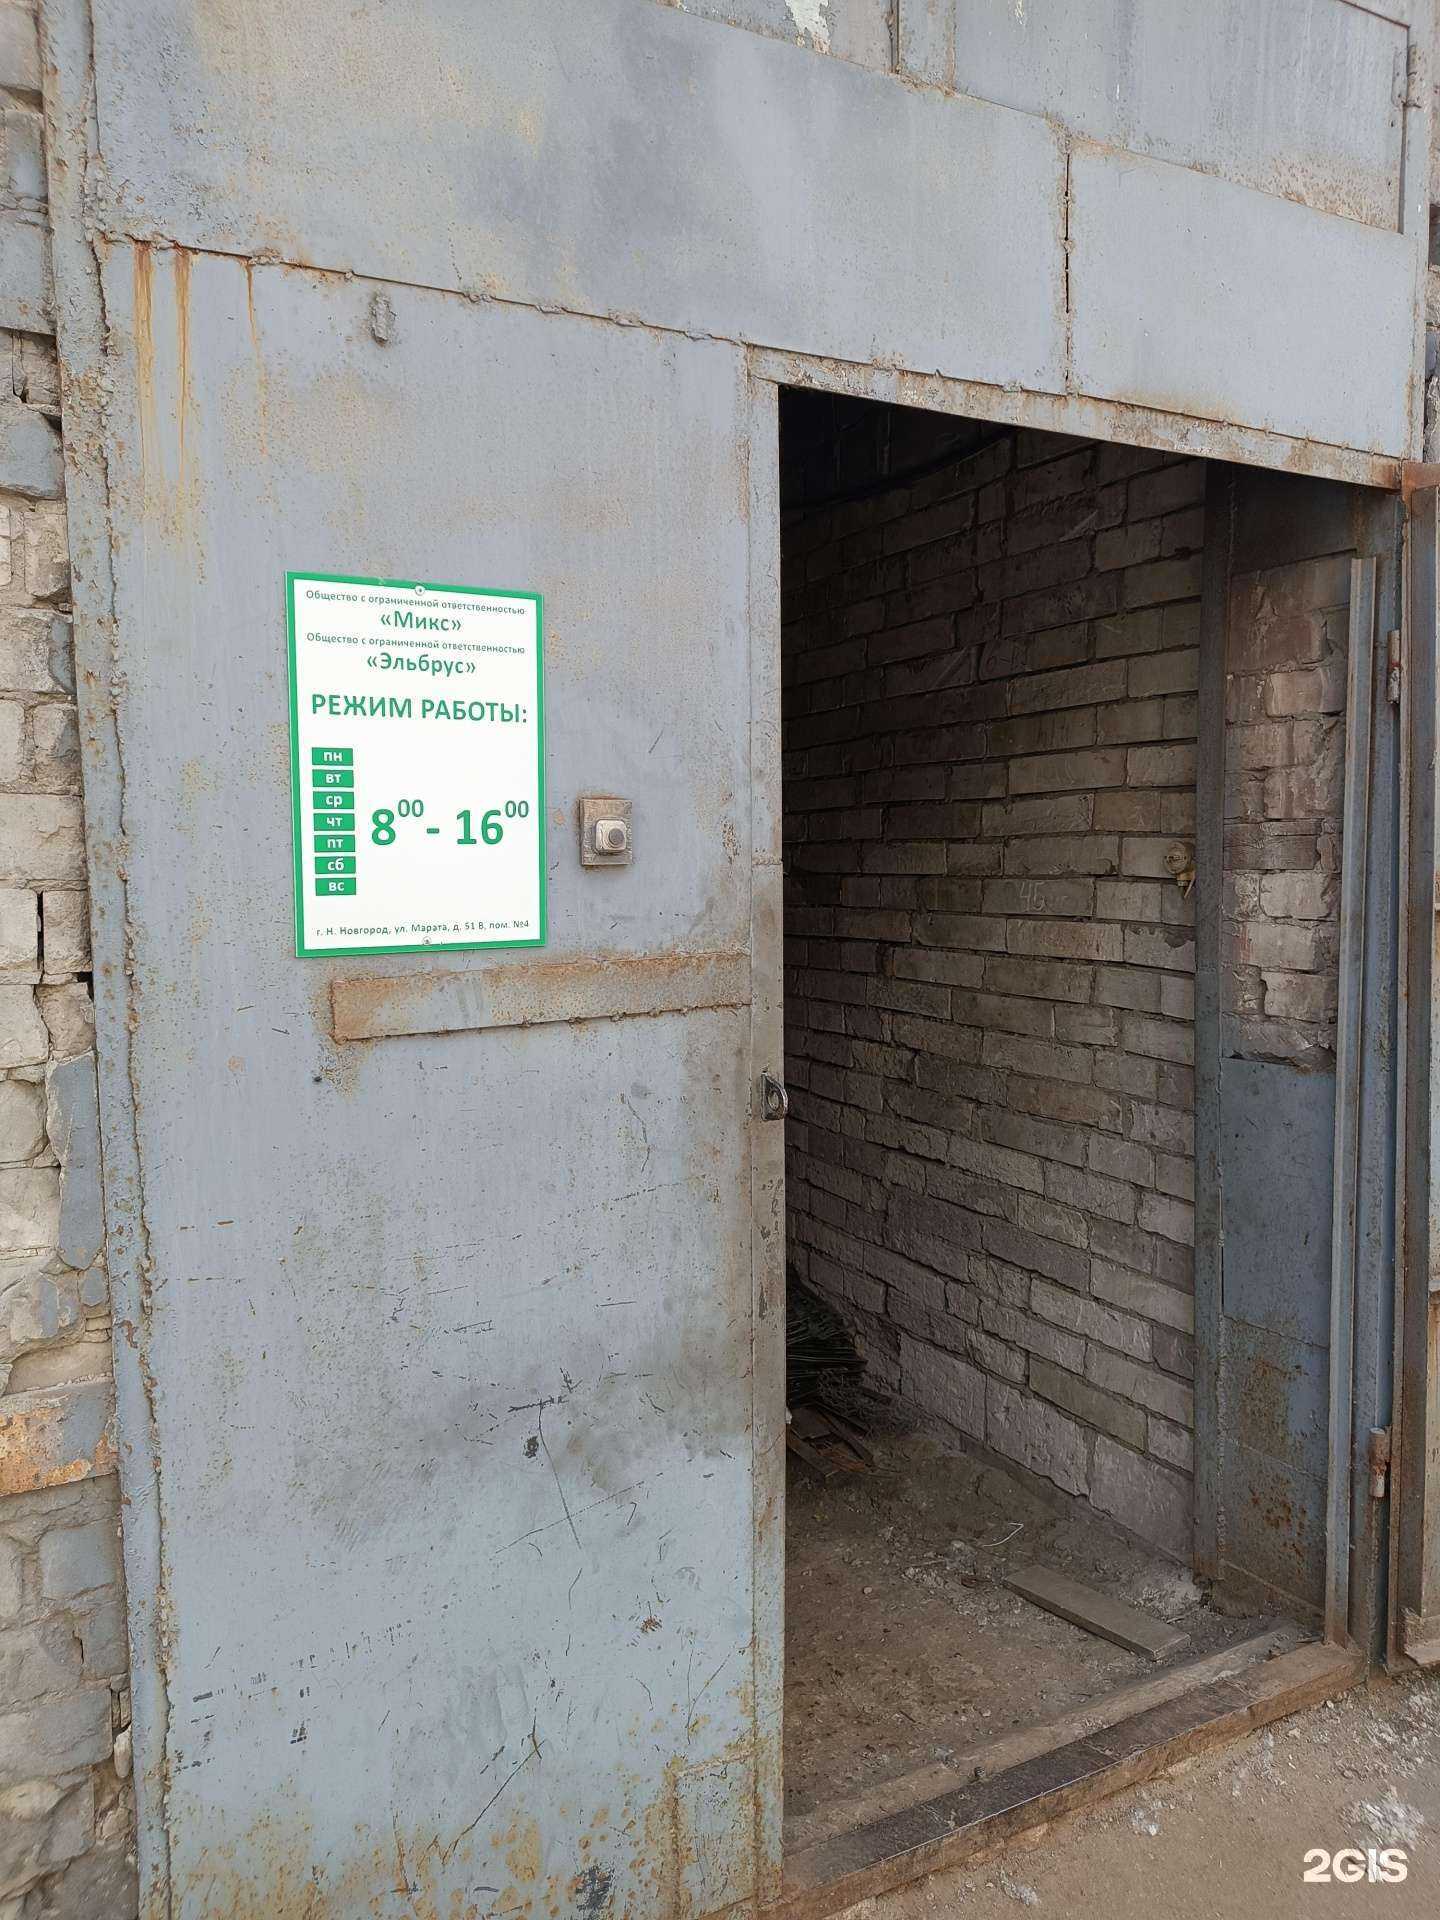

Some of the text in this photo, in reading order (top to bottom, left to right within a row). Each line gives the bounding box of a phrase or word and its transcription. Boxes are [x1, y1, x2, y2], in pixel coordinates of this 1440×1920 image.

[306, 590, 358, 602] Общество
[368, 595, 439, 609] ограниченной
[441, 601, 525, 615] ответственностью
[380, 610, 462, 632] «Микс»
[306, 632, 358, 644] Общество
[368, 637, 440, 649] ограниченной
[442, 642, 525, 654] ответственностью
[367, 652, 476, 677] «Эльбрус»
[311, 693, 527, 723] РЕЖИМ РАБОТЫ:
[323, 751, 343, 762] пн
[325, 773, 341, 783] вт
[325, 795, 342, 807] ср
[326, 817, 342, 827] чт
[327, 838, 343, 848] пт
[327, 857, 344, 871] сб
[328, 882, 344, 892] вс
[316, 929, 323, 937] г.
[326, 927, 337, 936] Н.
[339, 926, 392, 936] Новгород,
[394, 925, 408, 935] ул.
[411, 923, 450, 934] Марата,
